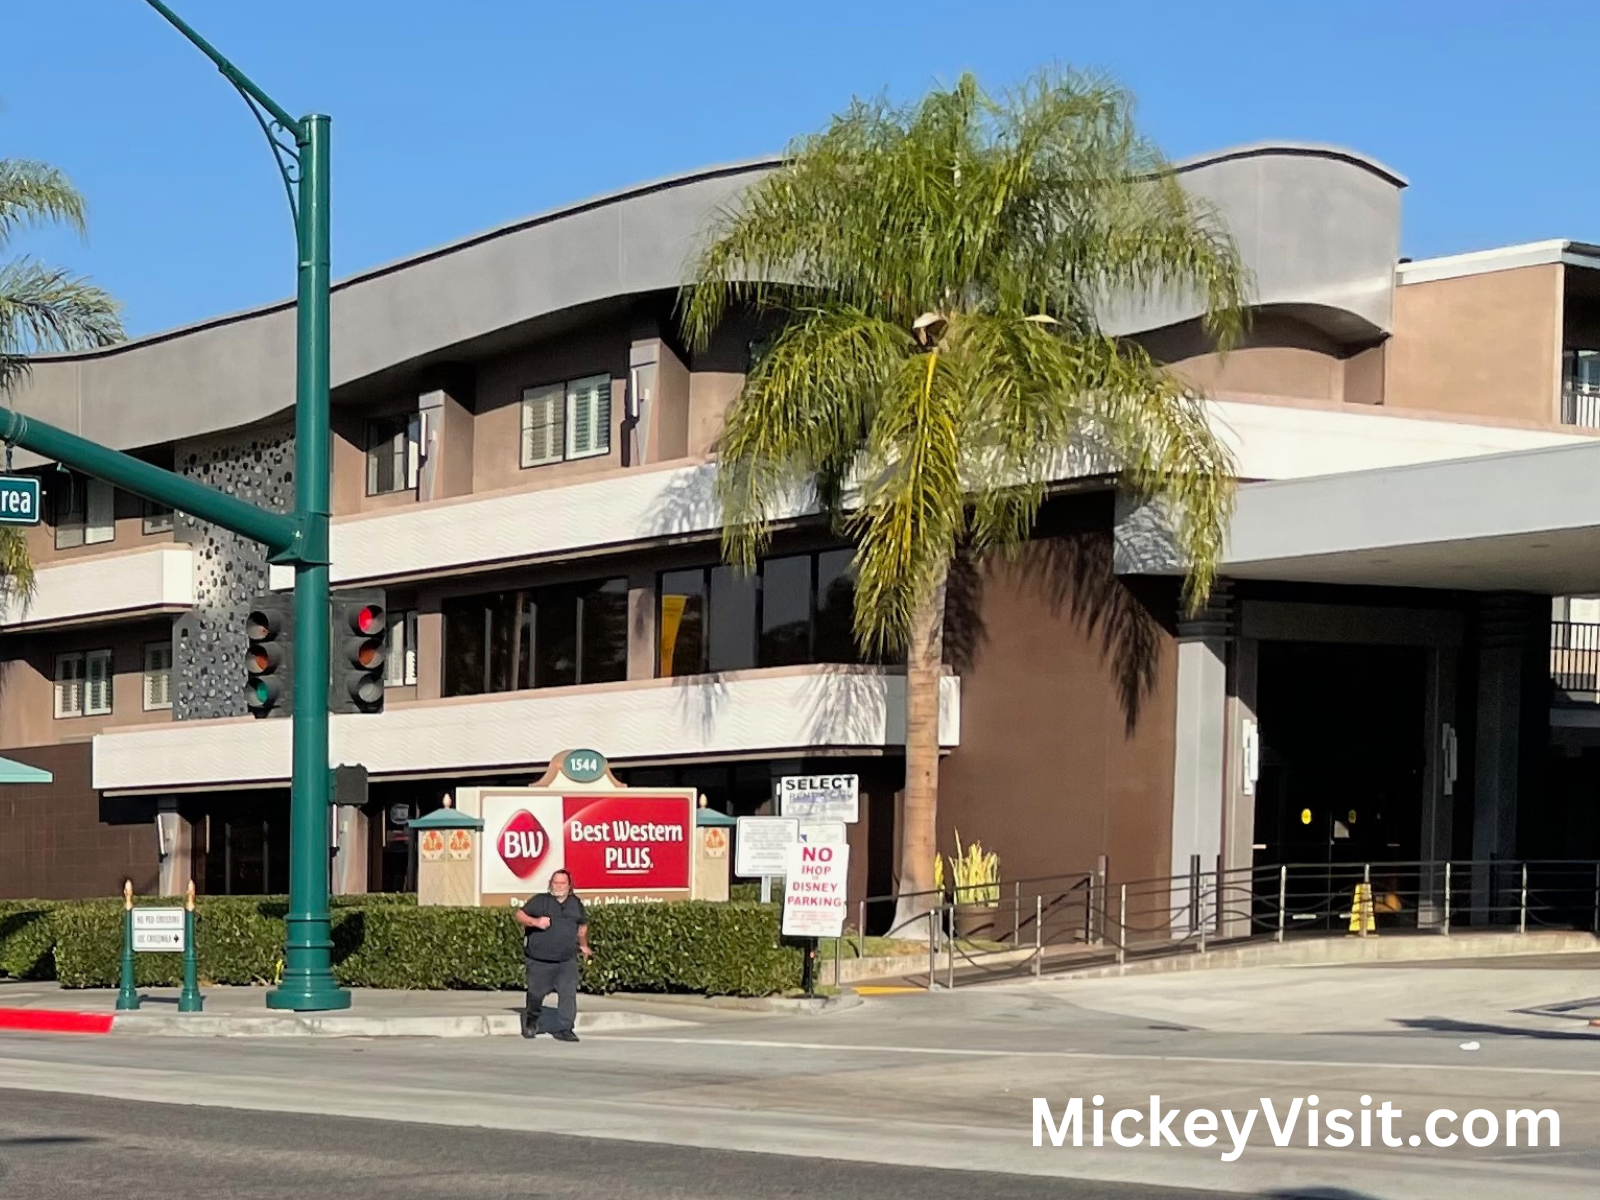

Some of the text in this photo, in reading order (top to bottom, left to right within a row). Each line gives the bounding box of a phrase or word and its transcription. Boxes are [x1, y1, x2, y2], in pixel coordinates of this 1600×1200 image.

[570, 757, 597, 772] 1544
[785, 776, 855, 791] SELECT
[570, 820, 683, 842] Best Western
[504, 831, 543, 858] BW
[802, 846, 833, 862] NO
[801, 865, 831, 875] IHOP
[792, 881, 838, 893] DISNEY
[787, 895, 842, 907] PARKING
